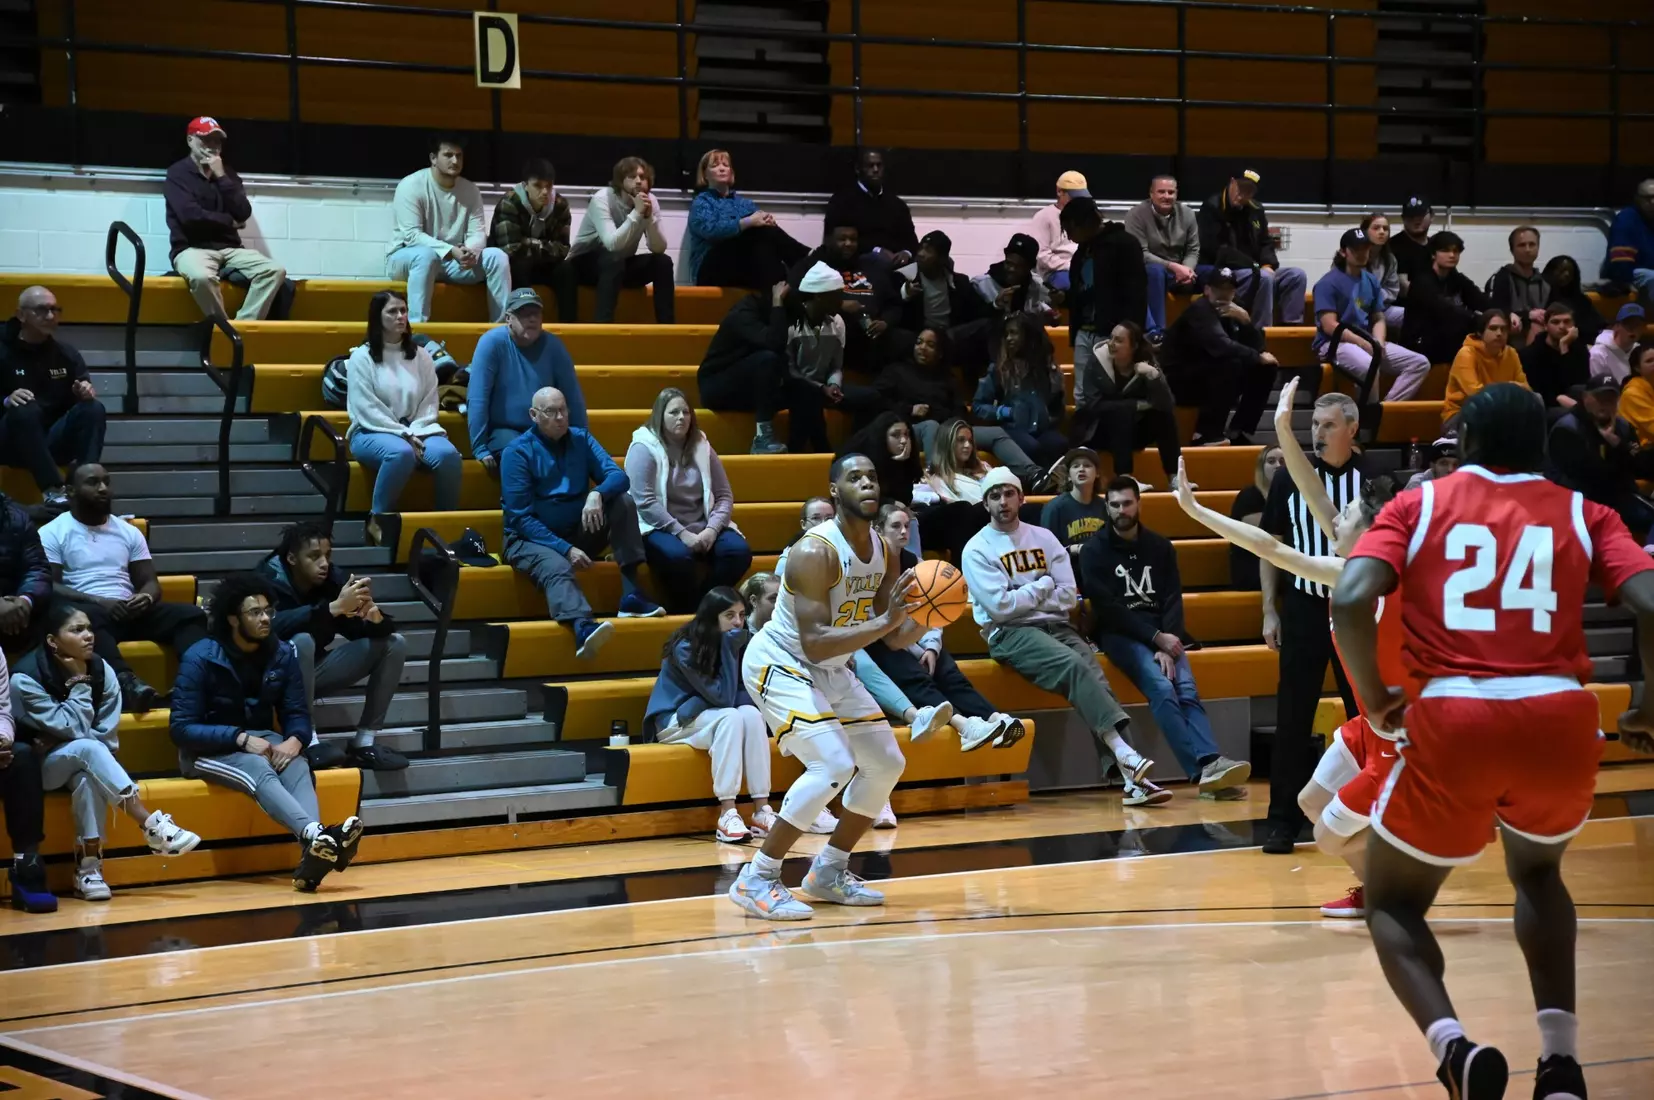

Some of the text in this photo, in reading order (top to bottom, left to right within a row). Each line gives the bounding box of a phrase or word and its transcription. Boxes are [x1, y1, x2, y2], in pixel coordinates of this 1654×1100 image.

[478, 15, 516, 84] D
[1116, 564, 1156, 602] M
[1443, 522, 1557, 634] 24
[832, 597, 873, 628] 25
